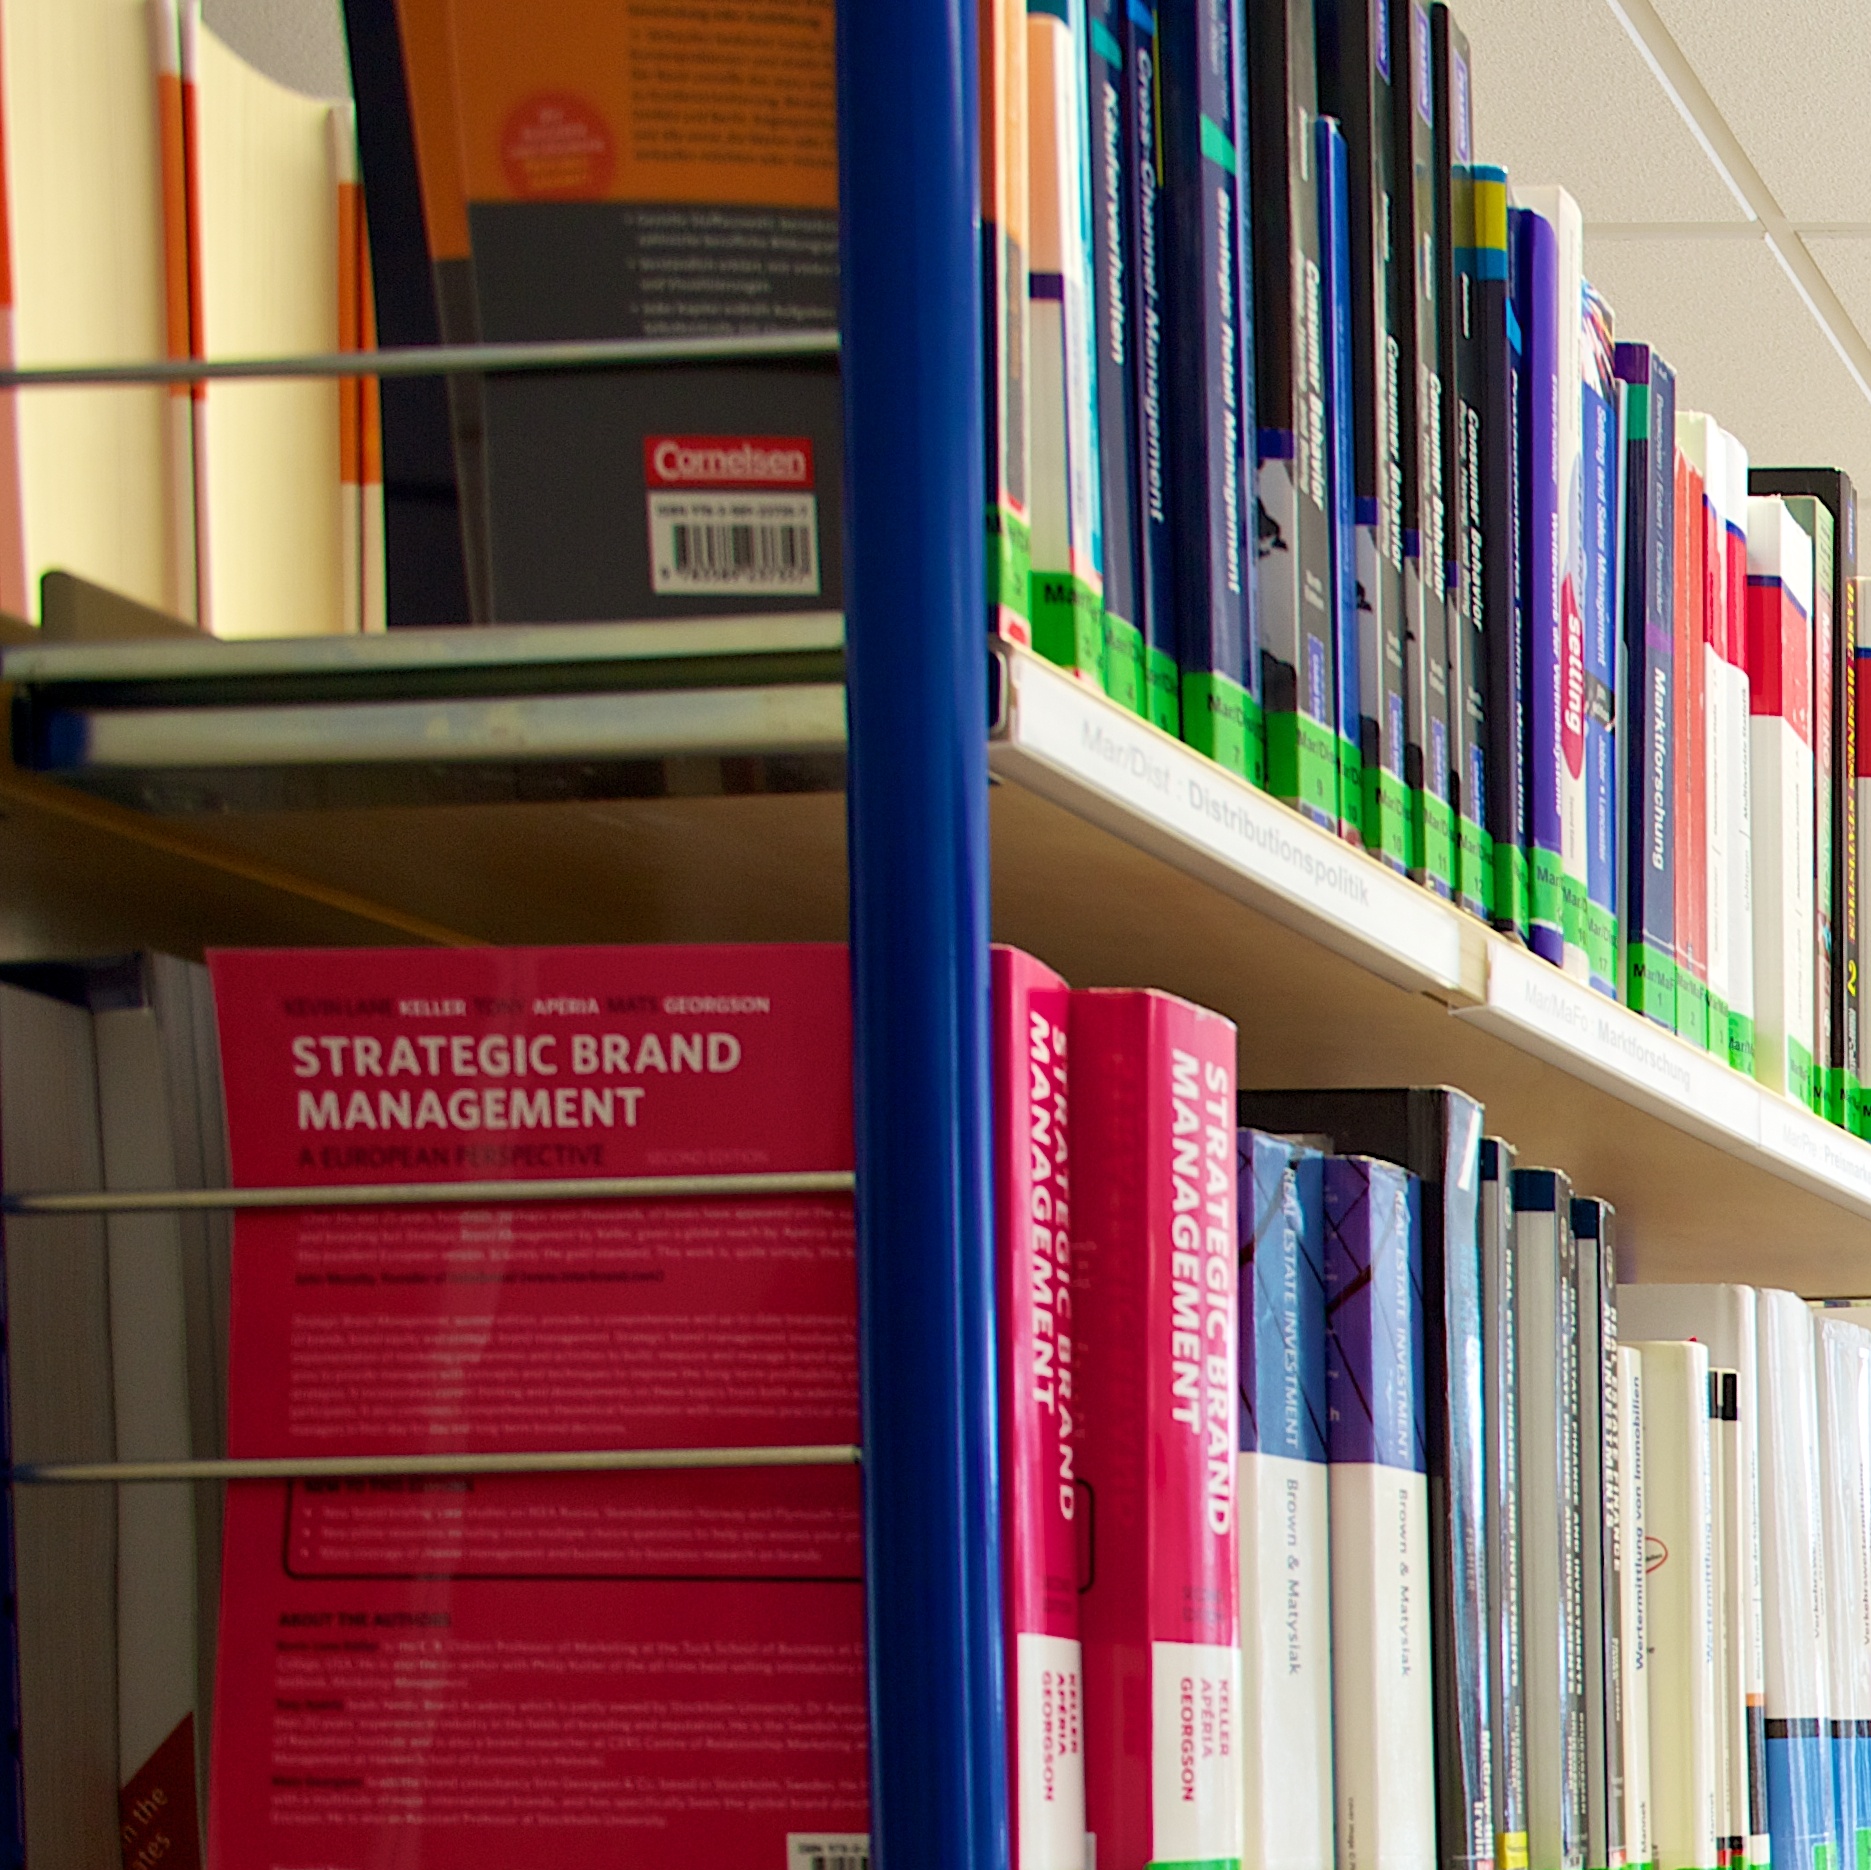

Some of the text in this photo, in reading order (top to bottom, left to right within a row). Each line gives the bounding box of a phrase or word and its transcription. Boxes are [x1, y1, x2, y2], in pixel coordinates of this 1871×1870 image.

[1216, 187, 1240, 594] Strategic Retail Management
[1306, 395, 1324, 510] Behavior
[654, 441, 806, 481] Cornelsen
[1467, 407, 1483, 631] Consumer Behavior
[1596, 404, 1610, 667] Selling and Sales Management
[1652, 667, 1667, 871] Marktforschung
[1189, 779, 1371, 909] Distributionspolitik
[399, 995, 770, 1017] KELLER GEORGSON
[1845, 958, 1858, 999] 2
[291, 1032, 742, 1078] STRATEGIC BRAND
[297, 1086, 644, 1130] MANAGEMENT
[1597, 1017, 1693, 1090] Marktforschung
[1028, 1010, 1055, 1415] MANAGEMENT
[1050, 1026, 1075, 1520] STRATEGIC BRAND
[1170, 1047, 1200, 1435] MANAGEMENT
[1205, 1064, 1228, 1533] STRATEGIC BRAND
[1283, 1168, 1304, 1450] REAL ESTATE INVESTMENT
[1395, 1243, 1410, 1461] ESTATE INVESTMENT
[1632, 1375, 1642, 1484] Immobilien
[1286, 1480, 1302, 1679] Brown Matysiak
[1397, 1487, 1411, 1680] Brown Matysiak
[1042, 1669, 1056, 1802] GEORGSON
[1056, 1672, 1067, 1757] APÉRIA
[1069, 1673, 1079, 1755] KELLER
[1180, 1676, 1194, 1803] GEORGSON
[1199, 1676, 1213, 1759] APÉRIA
[1216, 1678, 1231, 1757] KELLER
